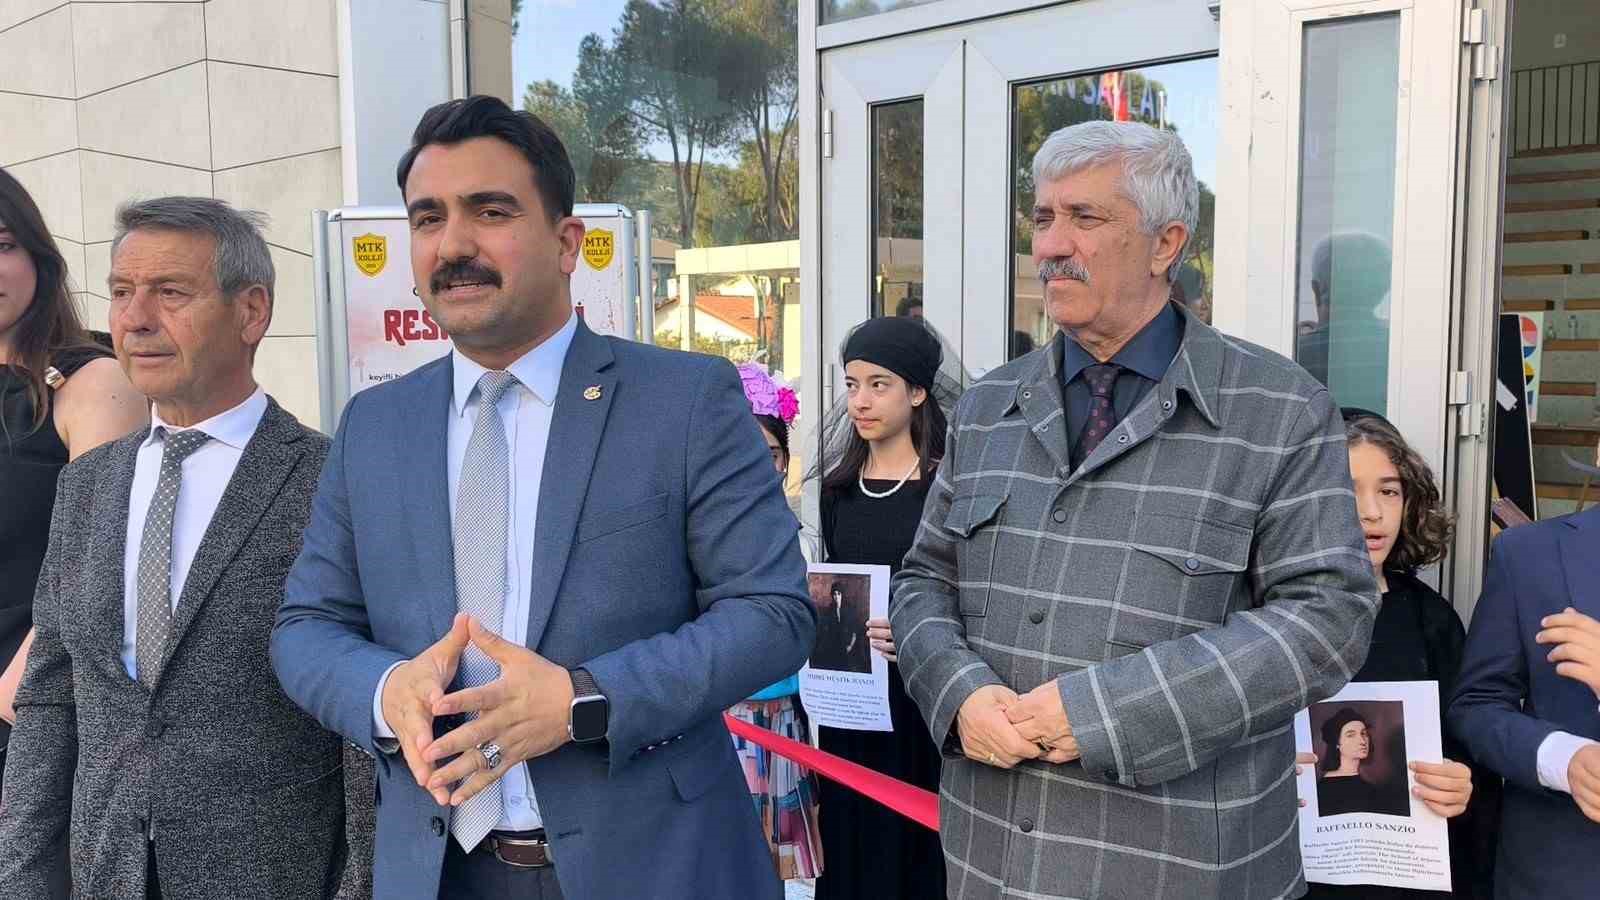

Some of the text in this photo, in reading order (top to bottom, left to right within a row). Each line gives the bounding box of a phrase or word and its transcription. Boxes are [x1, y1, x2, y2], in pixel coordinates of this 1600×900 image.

[357, 242, 383, 252] MTK
[585, 237, 610, 247] MTK
[1316, 822, 1373, 833] RAFFAELLO
